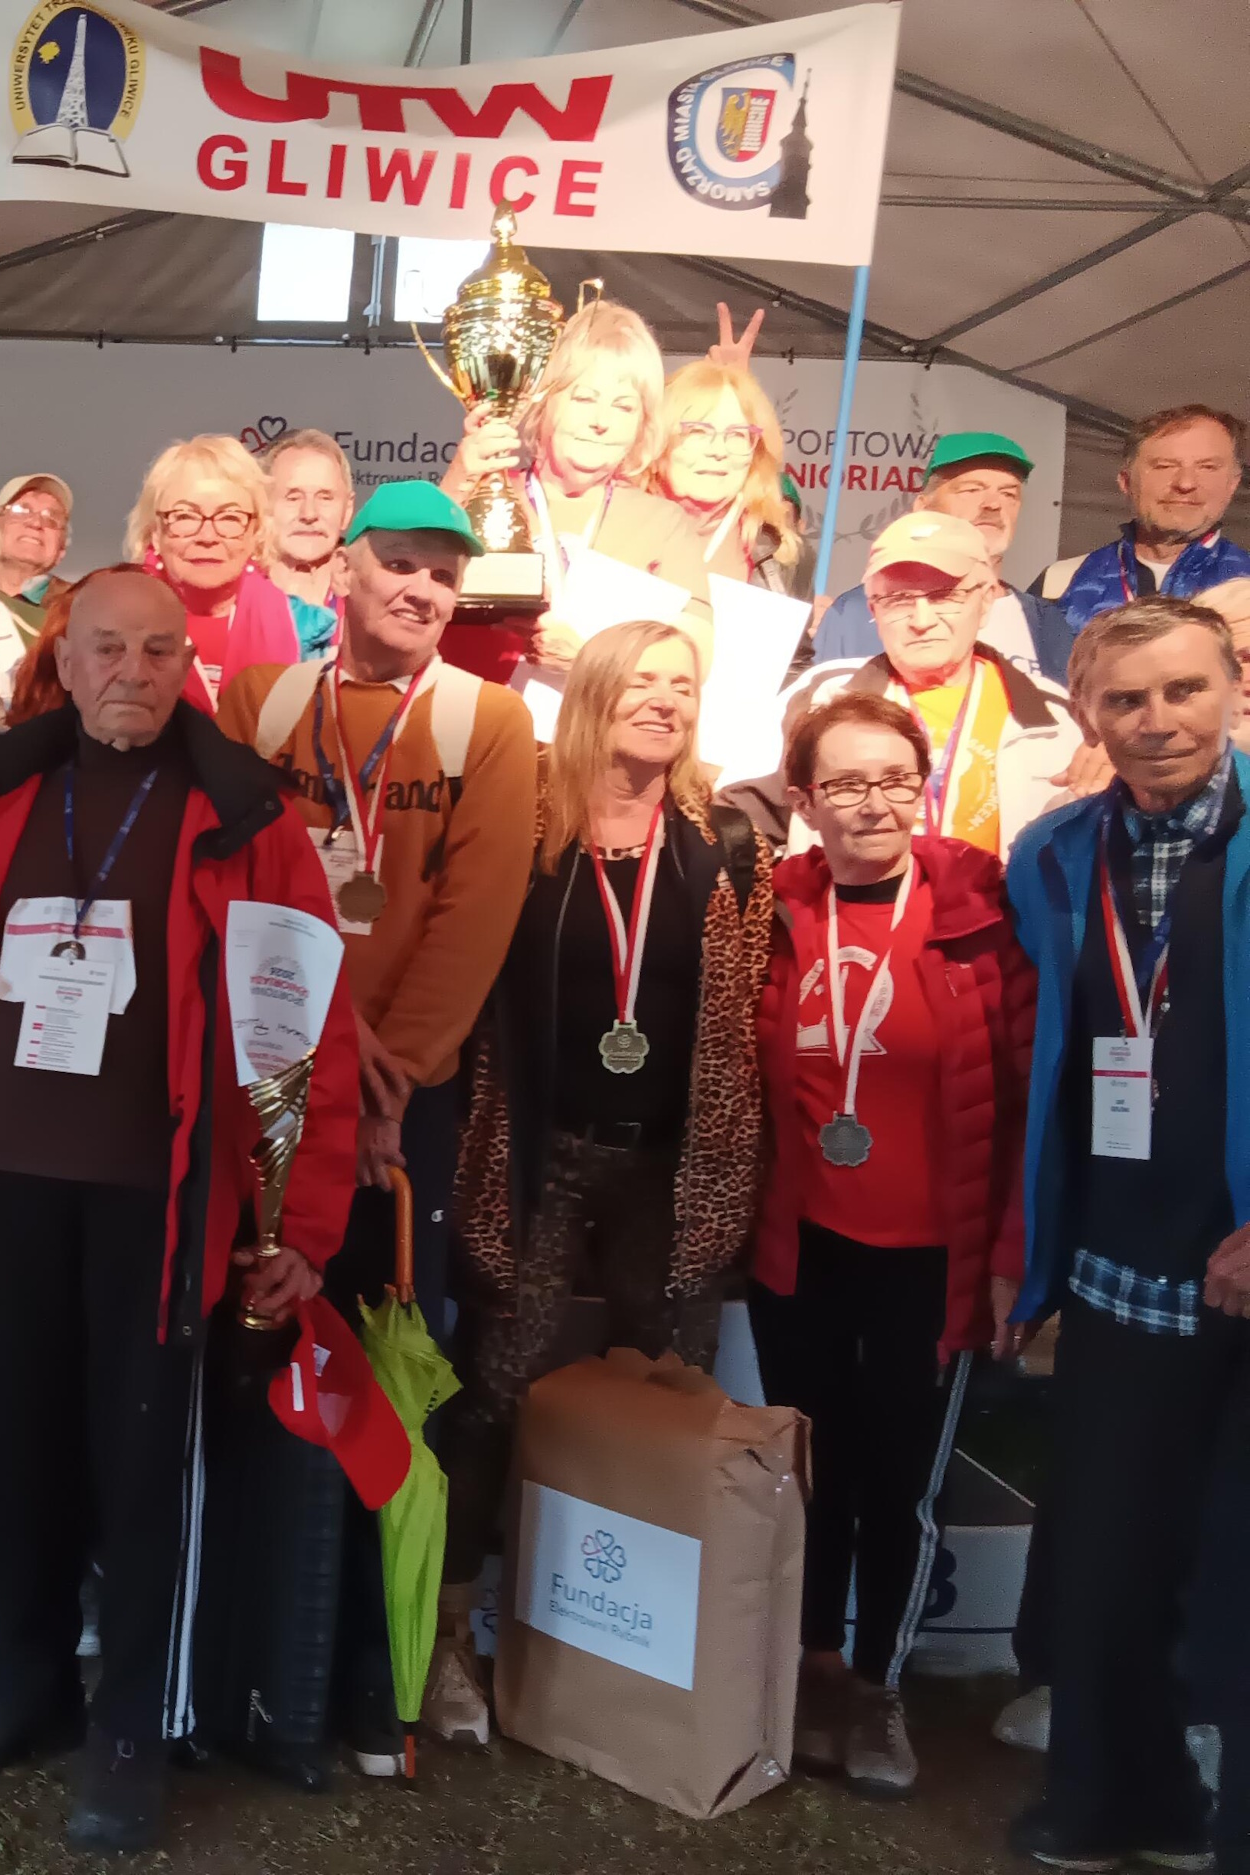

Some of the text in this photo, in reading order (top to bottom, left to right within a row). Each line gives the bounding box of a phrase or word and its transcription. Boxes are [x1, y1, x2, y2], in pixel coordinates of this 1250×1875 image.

[13, 12, 45, 110] UNIWERSYTET
[121, 58, 140, 119] GLIWICE
[673, 81, 702, 142] MIASTA
[197, 134, 604, 217] GLIWICE
[334, 432, 459, 464] Fundac
[551, 1572, 653, 1631] Fundacja
